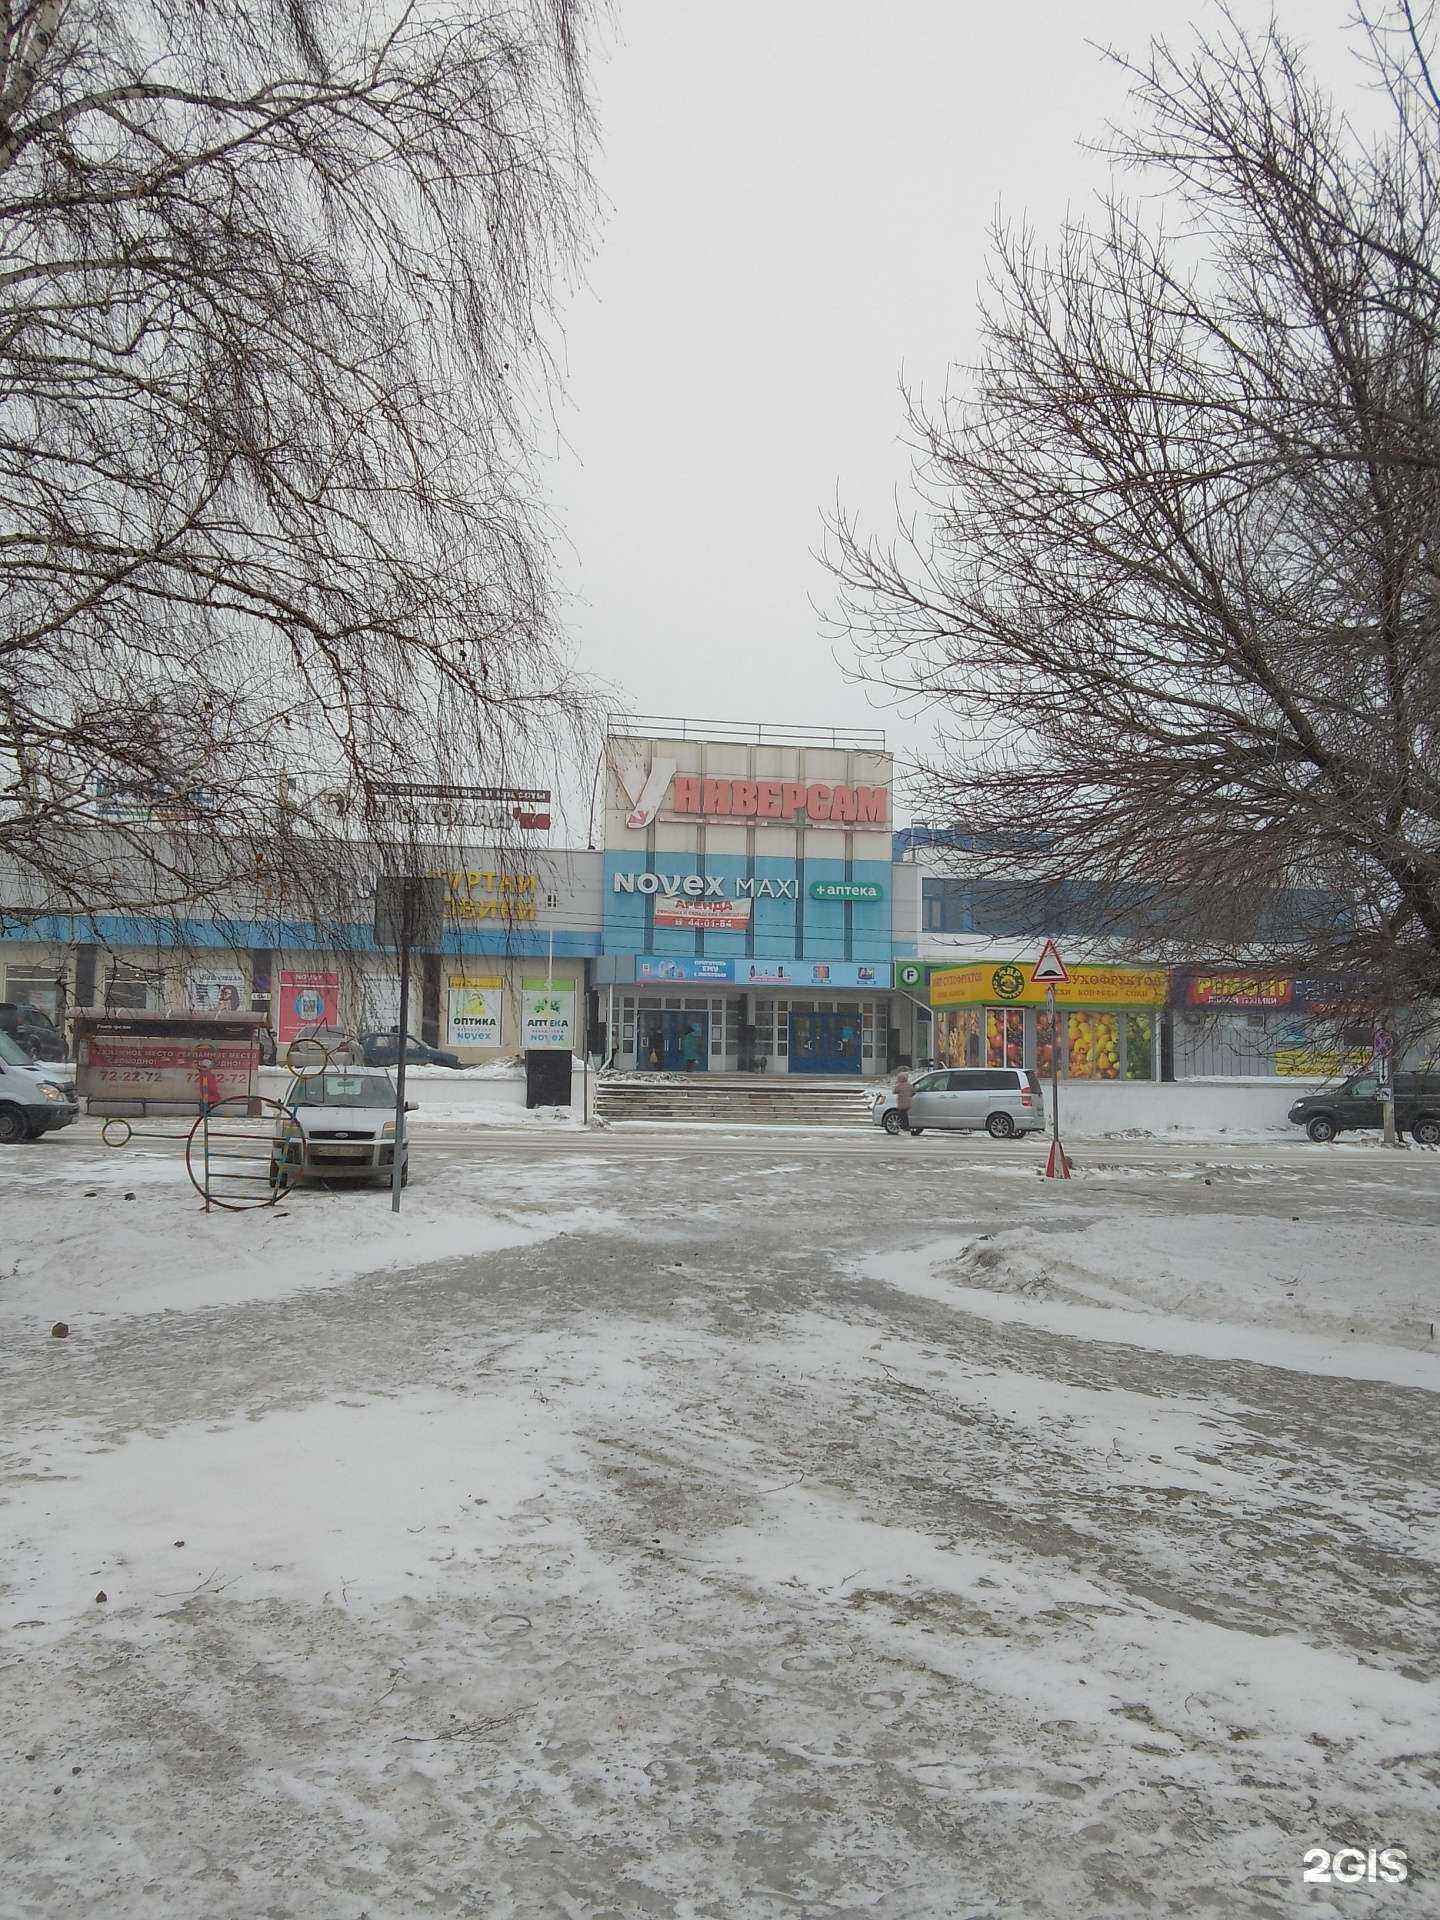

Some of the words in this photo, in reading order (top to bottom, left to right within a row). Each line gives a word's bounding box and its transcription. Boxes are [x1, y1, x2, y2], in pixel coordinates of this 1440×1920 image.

[606, 757, 888, 829] УНИВЕРСАМ
[736, 877, 799, 900] MAXI
[675, 900, 733, 912] АРЕНДА
[453, 1017, 496, 1026] ОПТИКА
[100, 1070, 162, 1083] 72-22-72
